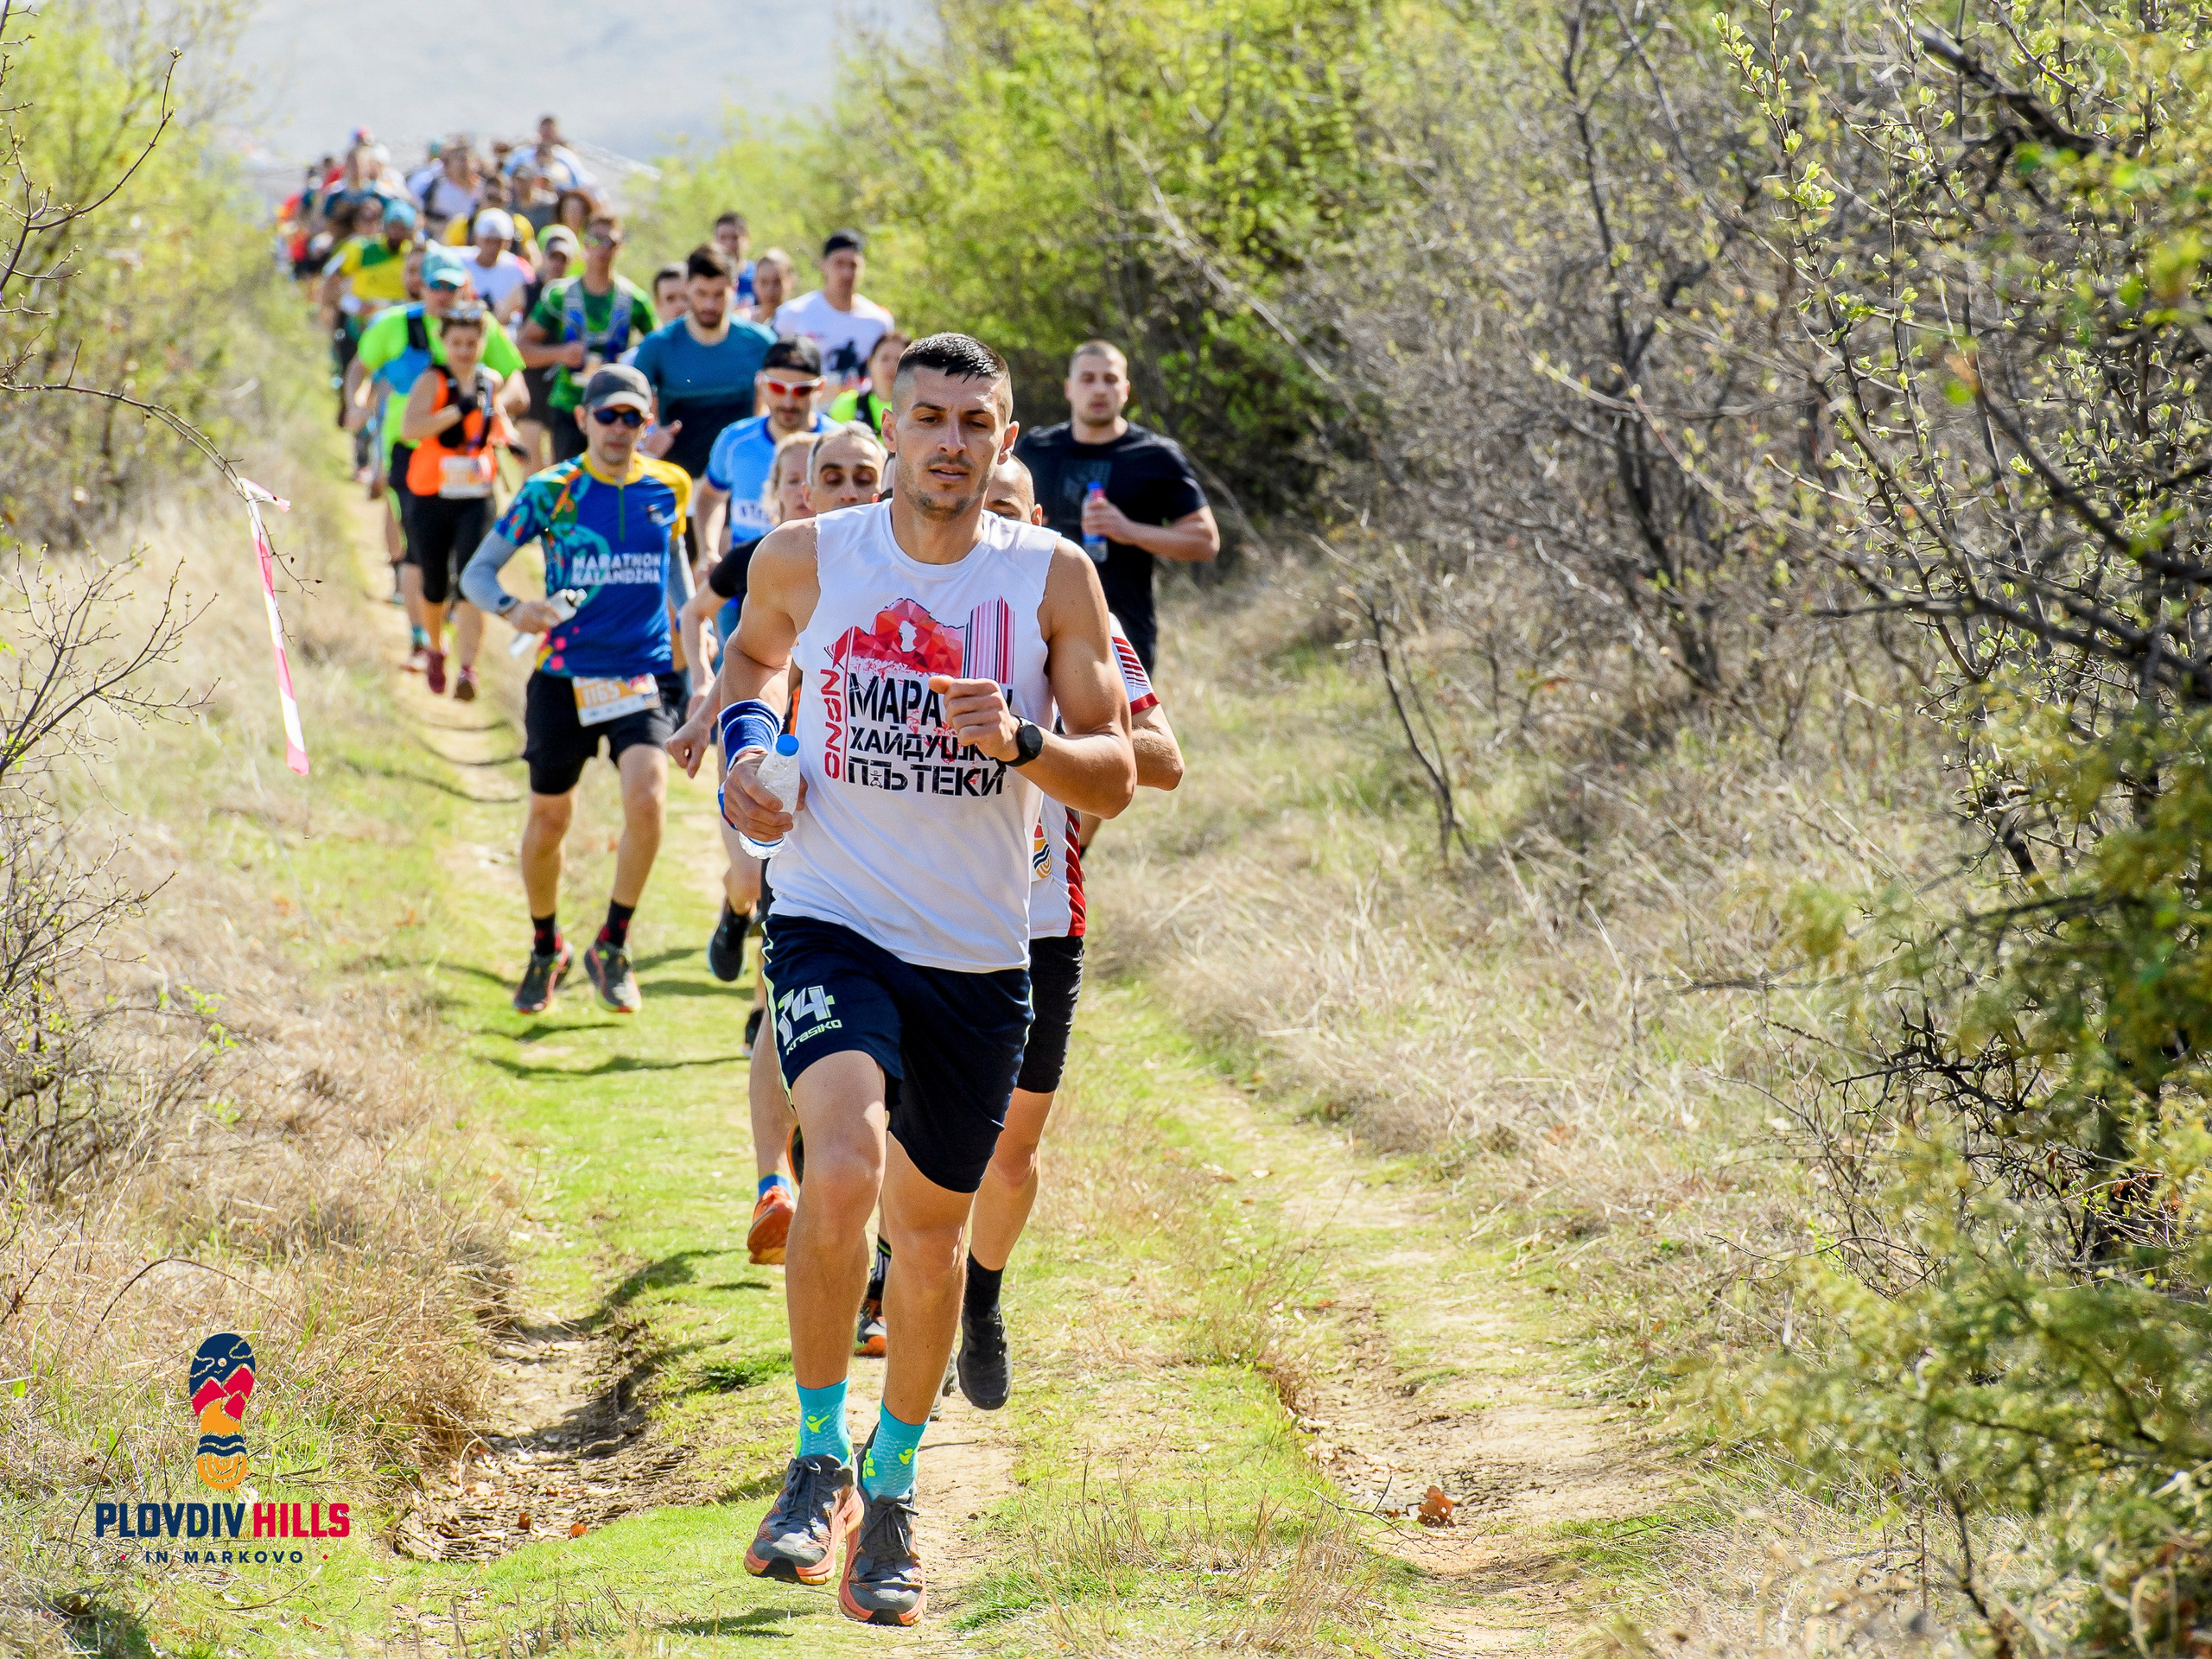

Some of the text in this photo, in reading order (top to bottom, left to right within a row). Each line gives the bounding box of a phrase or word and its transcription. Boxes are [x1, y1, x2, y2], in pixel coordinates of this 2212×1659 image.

[571, 552, 662, 569] MARATHON
[849, 671, 1014, 728] МАРА
[849, 724, 996, 763] ХАЙДУШК
[848, 755, 1007, 798] ПЪТЕКИ
